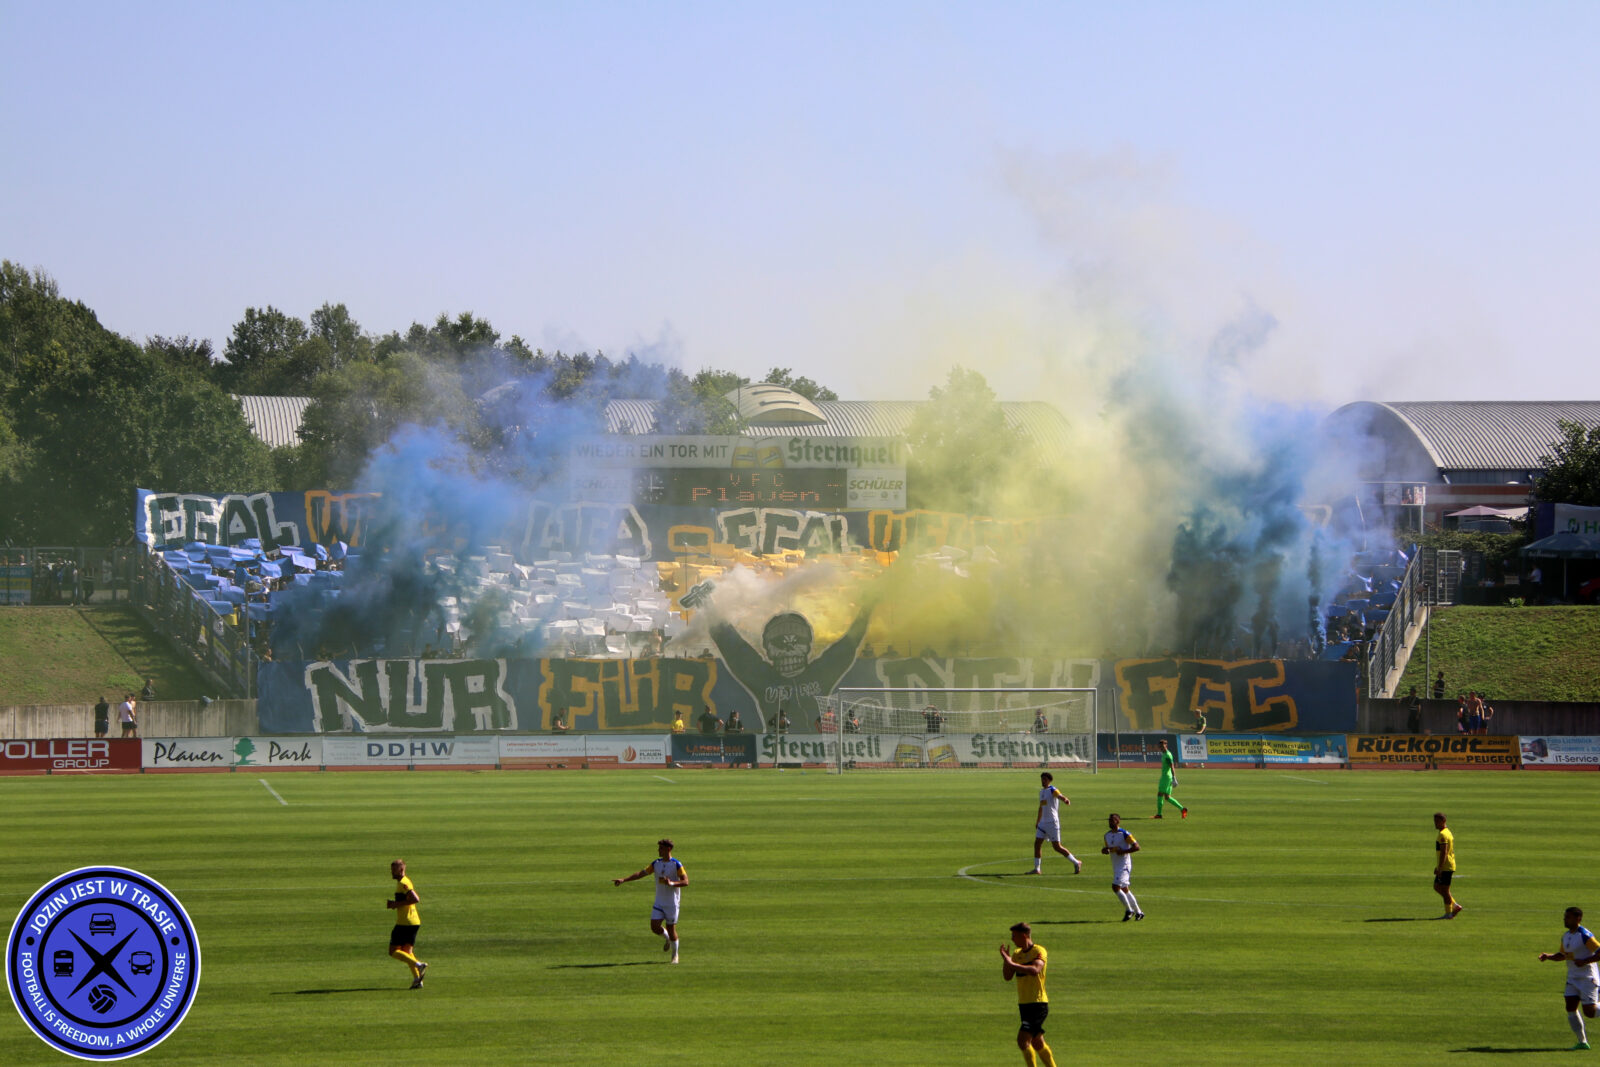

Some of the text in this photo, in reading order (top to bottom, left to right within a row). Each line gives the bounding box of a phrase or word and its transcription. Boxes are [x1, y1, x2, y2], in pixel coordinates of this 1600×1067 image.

[576, 444, 729, 459] WIEDER EIN TOR MIT
[788, 436, 901, 467] Sternquell
[849, 476, 904, 490] SCHÜLER
[692, 487, 820, 502] Plauen
[145, 492, 301, 556] EGAL
[305, 658, 518, 732] NUR
[0, 741, 109, 758] OLLER
[367, 742, 455, 757] DDHW
[762, 734, 881, 760] Sternquell
[971, 732, 1089, 762] Sternquell
[1356, 736, 1490, 753] Rückoldt
[154, 742, 223, 764] Plauen
[268, 742, 312, 763] Park
[1380, 754, 1433, 763] PEUGEOT
[1466, 755, 1520, 764] PEUGEOT
[1555, 755, 1599, 763] IT-Service
[53, 759, 109, 768] GROUP
